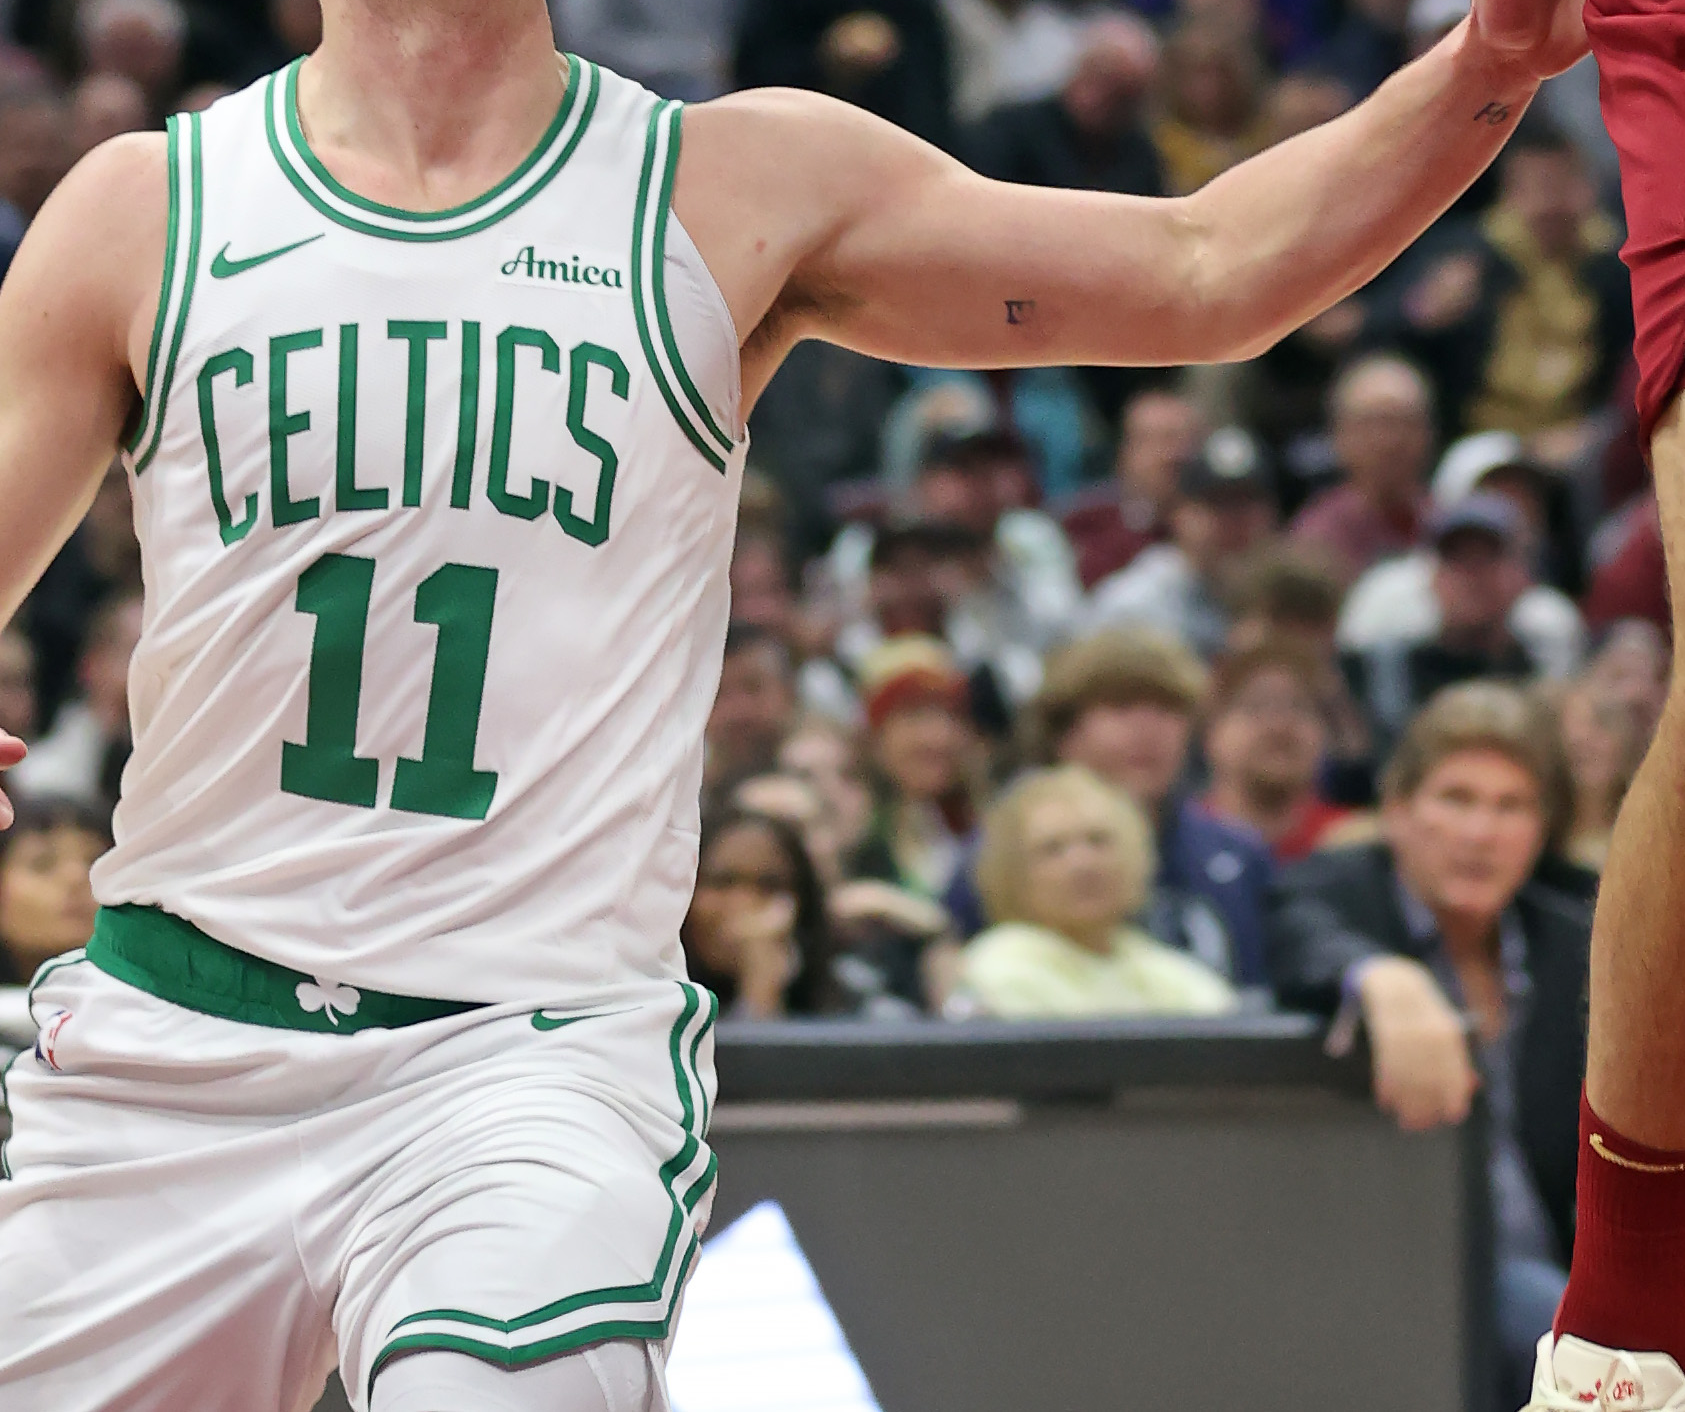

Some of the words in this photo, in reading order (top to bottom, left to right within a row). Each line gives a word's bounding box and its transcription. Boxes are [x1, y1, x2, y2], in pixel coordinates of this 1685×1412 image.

[500, 245, 624, 289] Amica
[197, 320, 630, 547] CELTICS
[281, 552, 499, 821] 11
